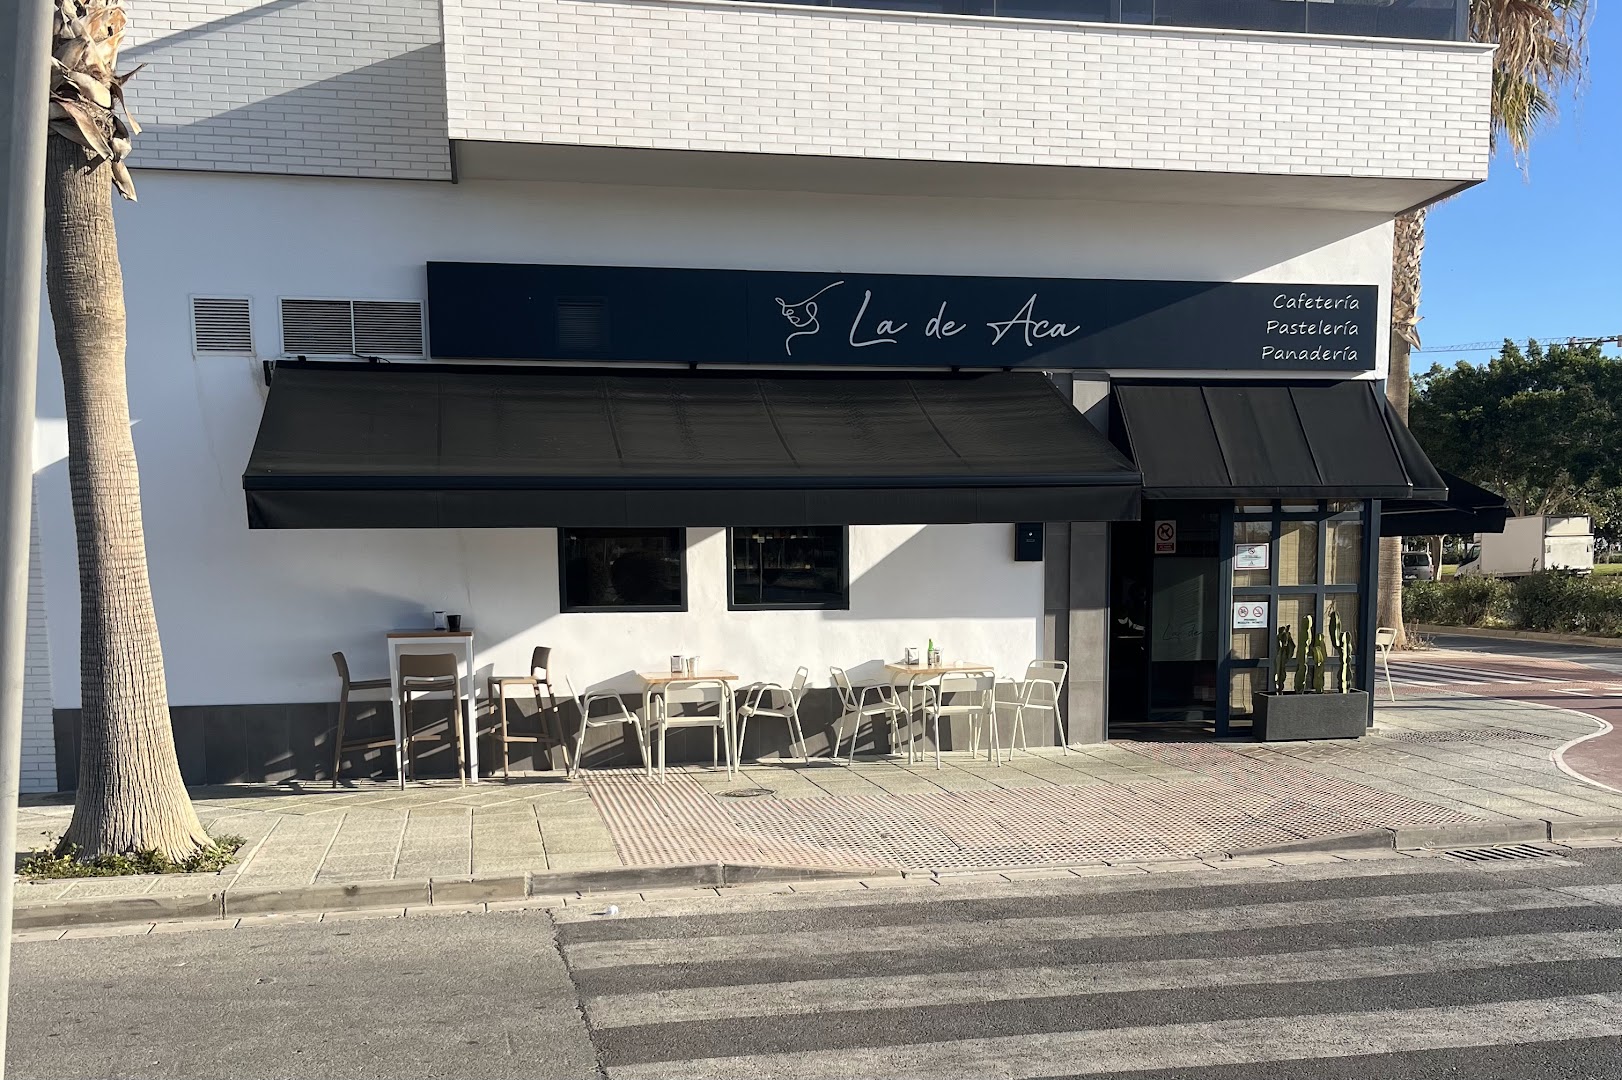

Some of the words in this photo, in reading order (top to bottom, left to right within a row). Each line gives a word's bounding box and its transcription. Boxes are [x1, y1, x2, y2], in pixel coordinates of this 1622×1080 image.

[1273, 292, 1360, 310] Cafetería
[849, 289, 908, 347] La
[925, 301, 967, 339] de
[986, 293, 1081, 347] Aca
[1266, 319, 1359, 336] Pastelería
[1261, 344, 1358, 361] Panadería
